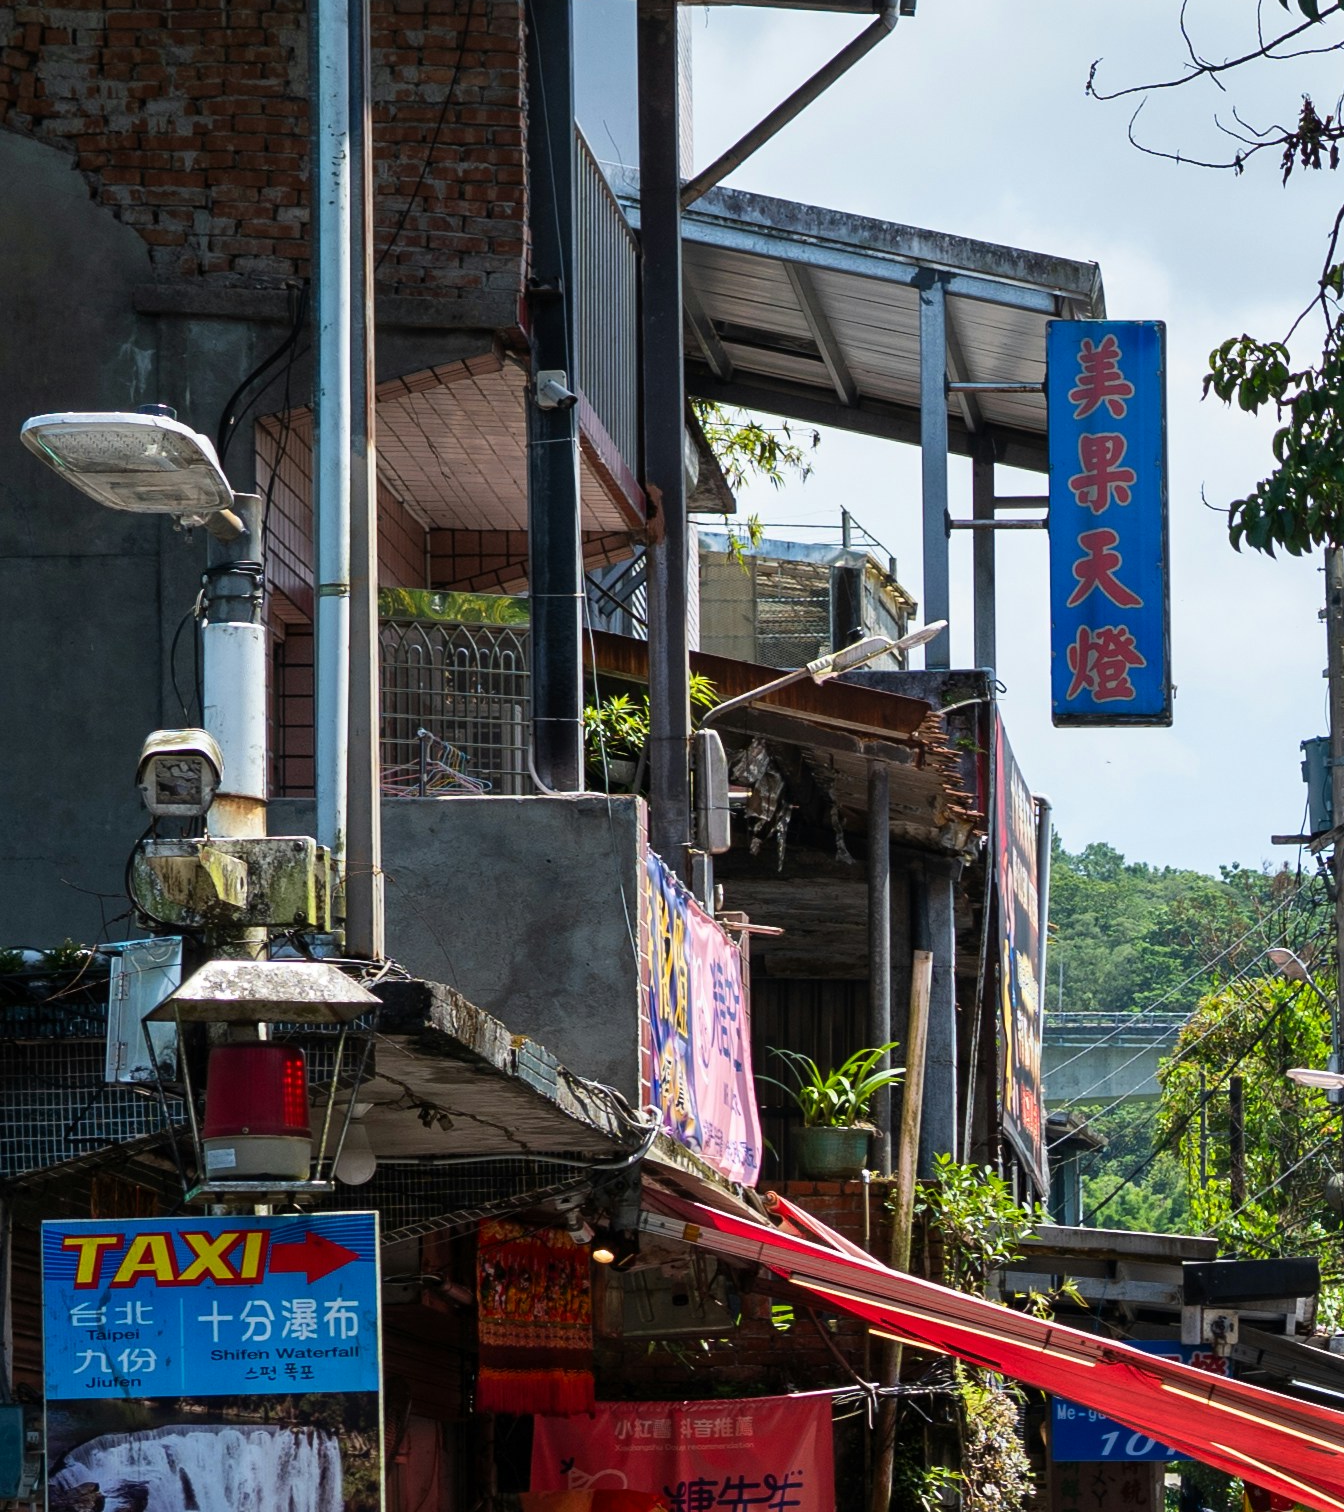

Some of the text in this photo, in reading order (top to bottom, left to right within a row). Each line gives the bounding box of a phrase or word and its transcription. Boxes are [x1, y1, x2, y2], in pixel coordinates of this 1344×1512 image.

[1066, 333, 1146, 704] 美果天燈
[62, 1231, 270, 1288] TAXI
[70, 1301, 153, 1328] 台北
[198, 1297, 360, 1342] 十分瀑布
[85, 1328, 140, 1343] Taipei
[73, 1349, 157, 1375] 九份
[210, 1346, 360, 1362] Shifen Waterfall
[85, 1375, 142, 1389] Jiufen
